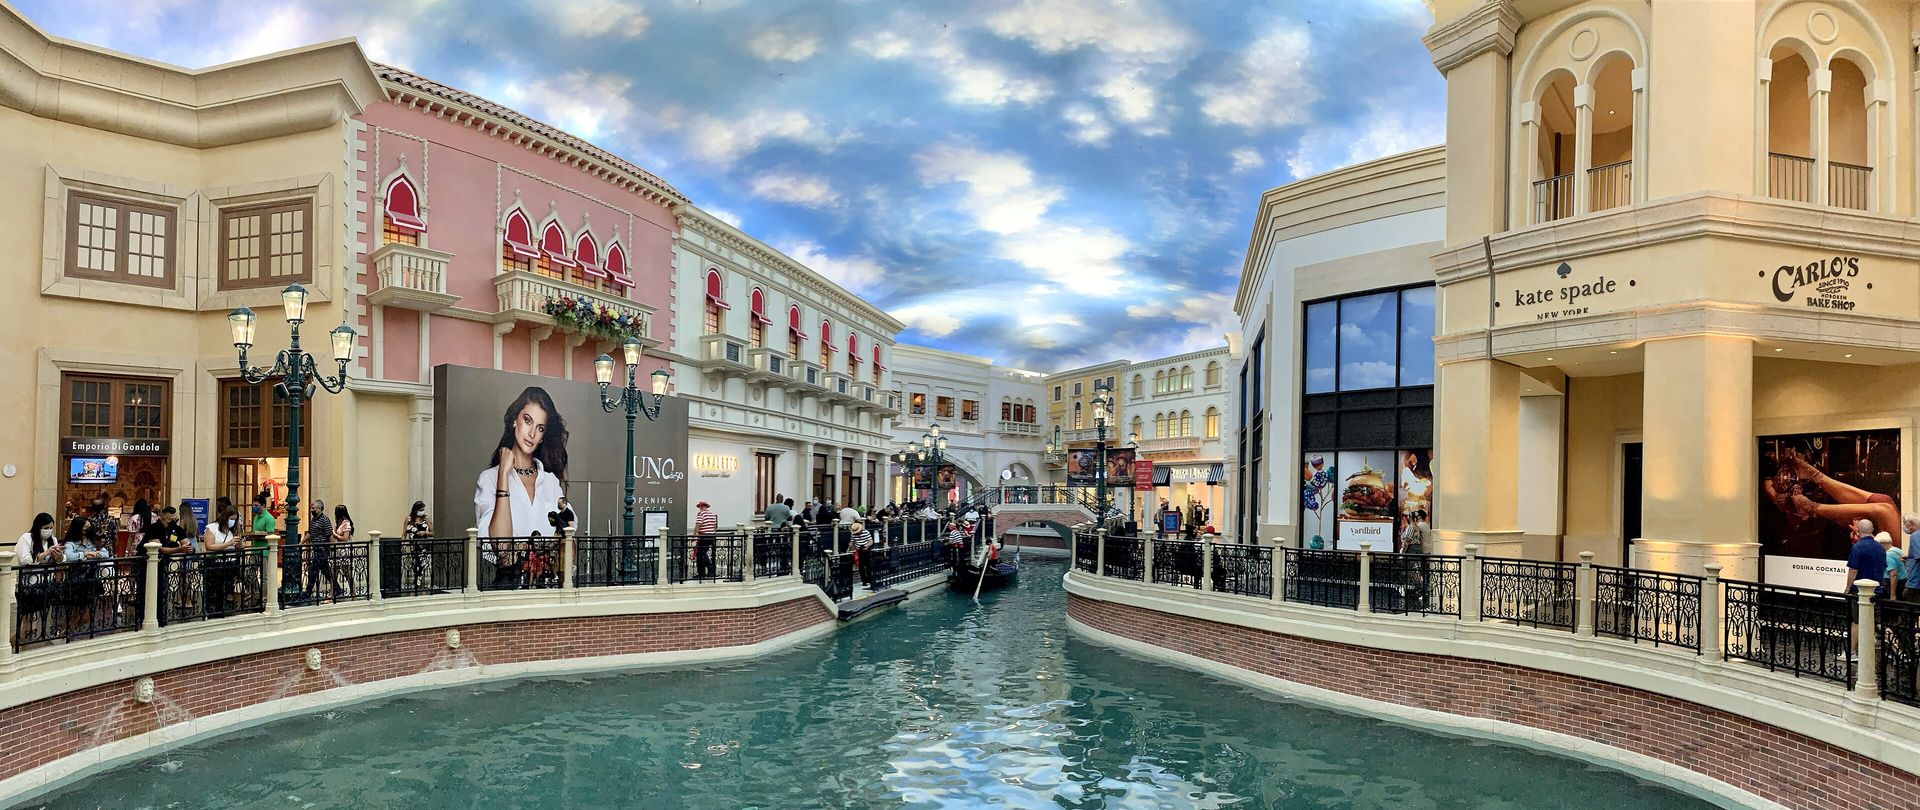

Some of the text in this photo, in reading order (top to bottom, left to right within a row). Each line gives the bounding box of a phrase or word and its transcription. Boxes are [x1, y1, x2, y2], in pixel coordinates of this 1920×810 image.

[1772, 256, 1859, 302] CARLO'S
[1818, 279, 1837, 289] SINCE
[1515, 276, 1616, 307] kate spade
[1806, 297, 1856, 311] BAKE SHOP
[1537, 307, 1589, 320] NEW YORK
[72, 441, 160, 452] Emporio Di Gondola
[633, 455, 675, 480] UNO
[1350, 526, 1381, 536] yardbird
